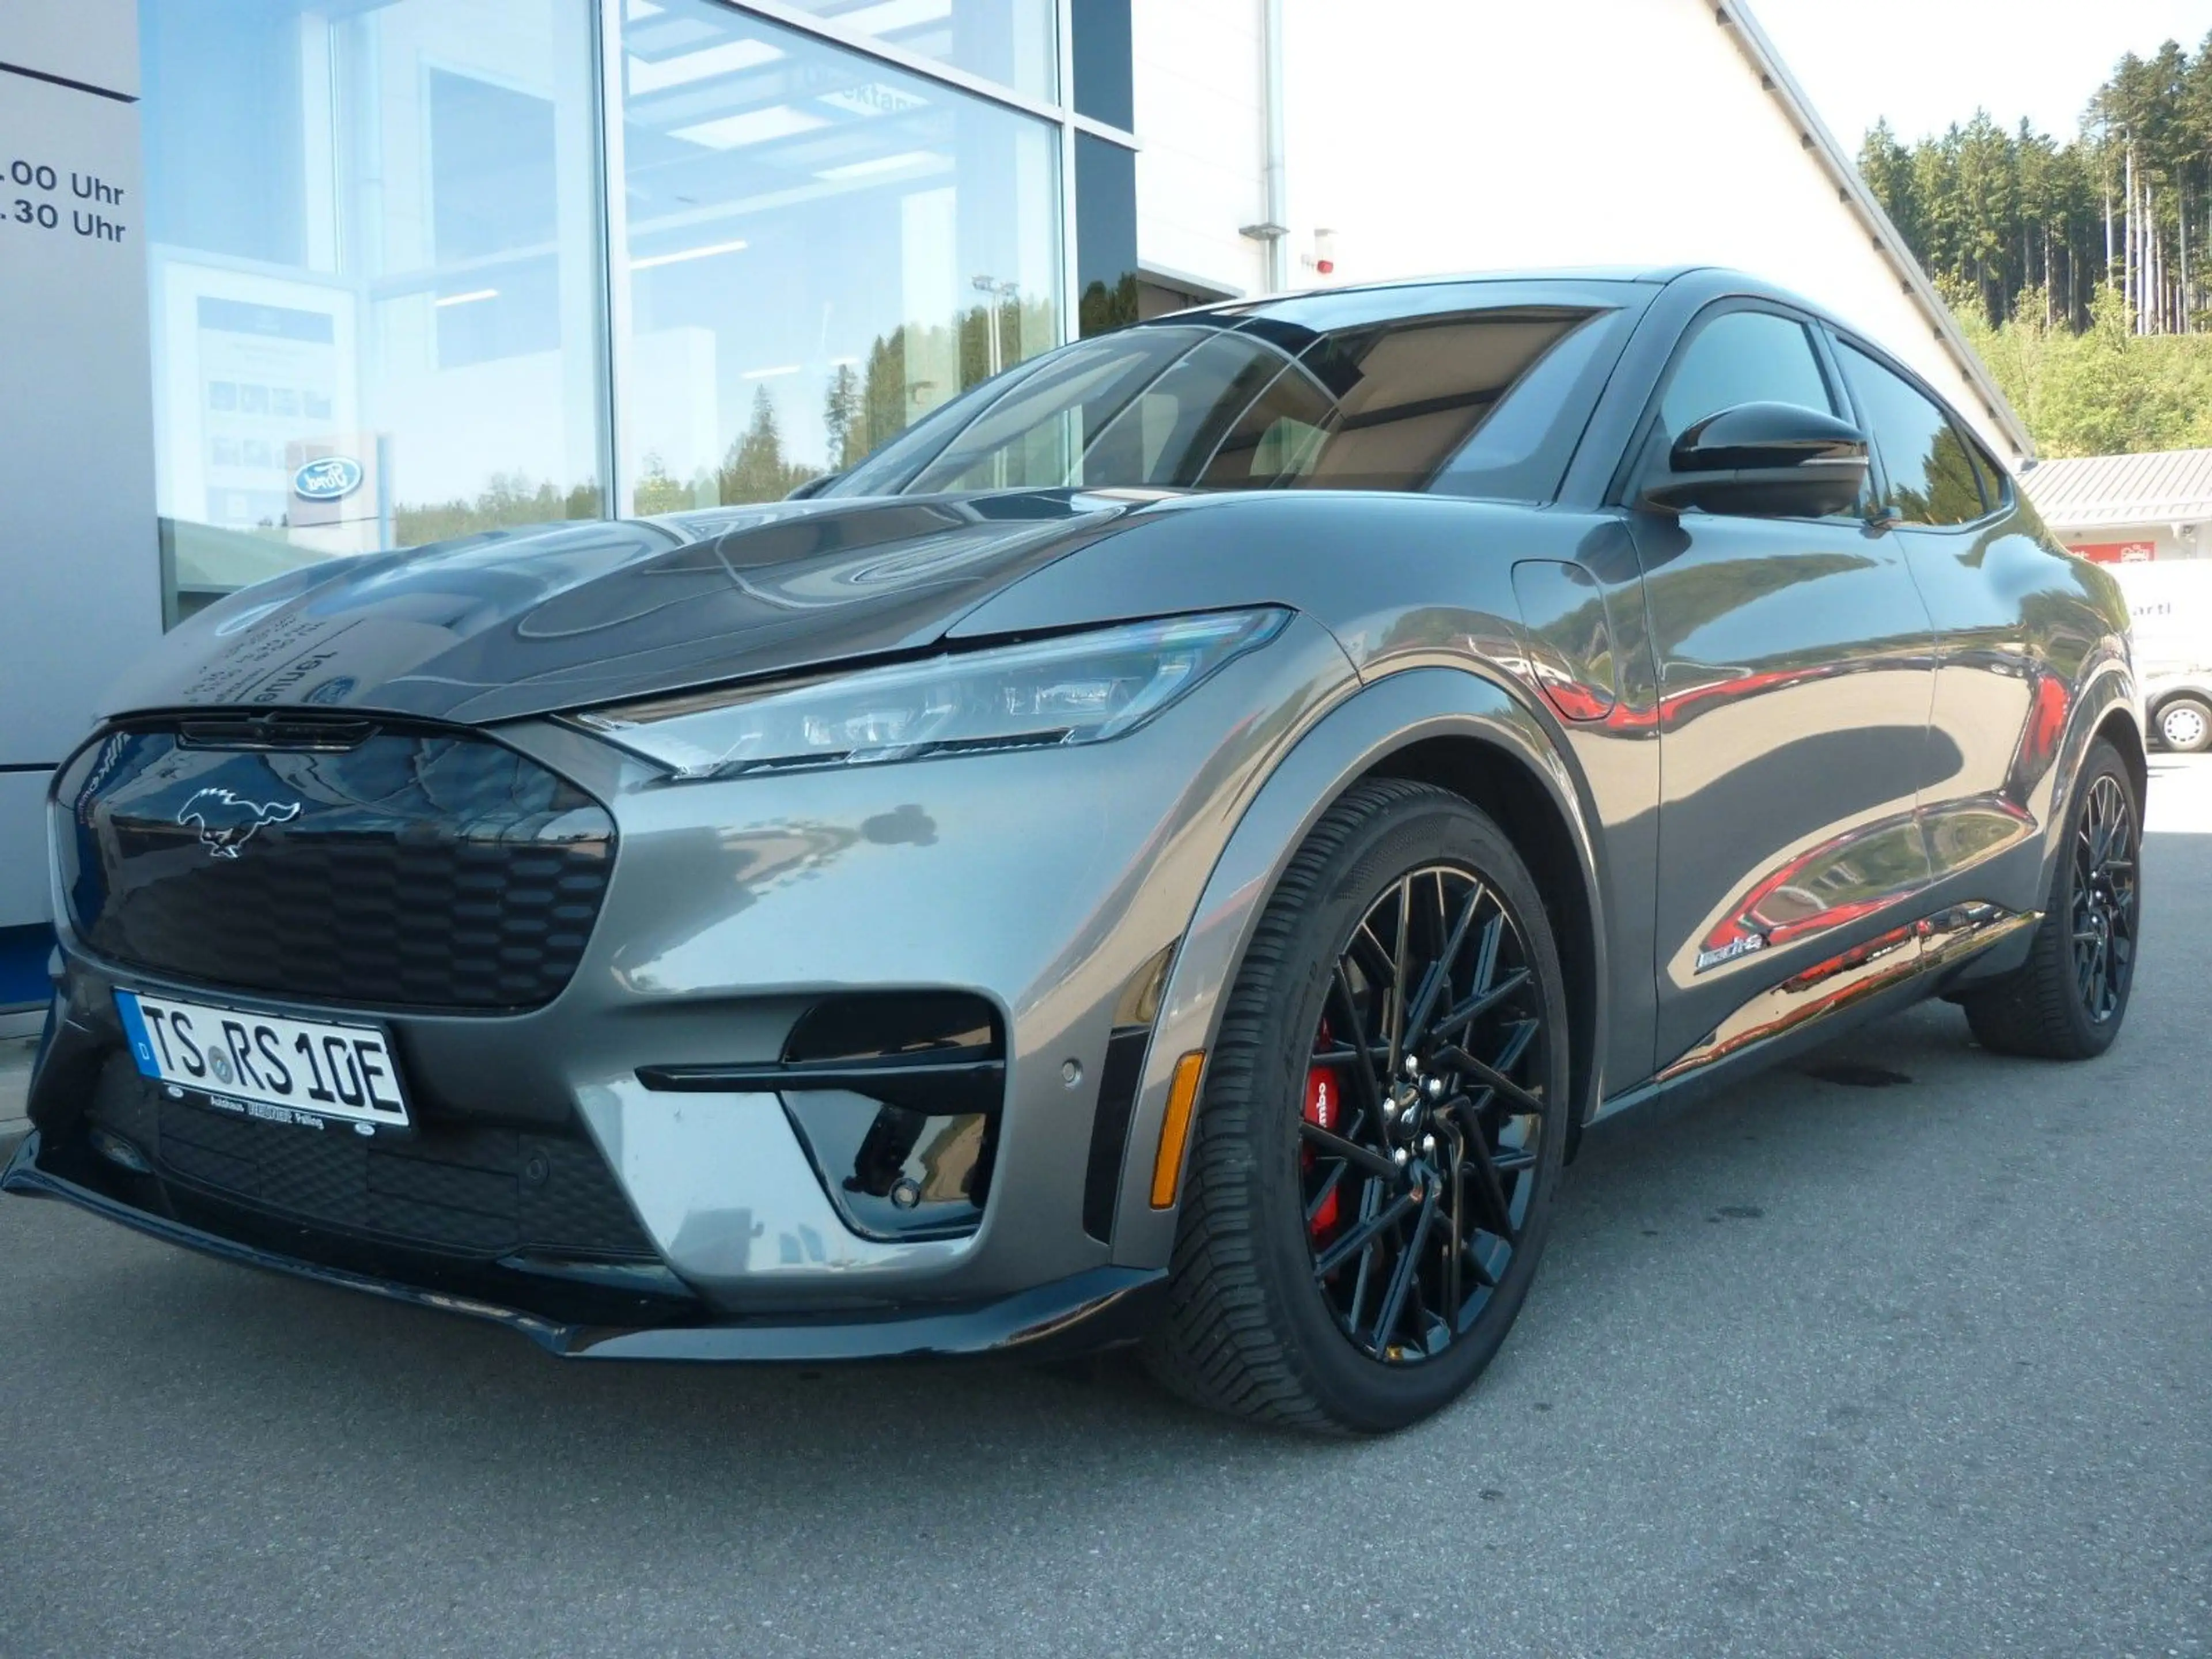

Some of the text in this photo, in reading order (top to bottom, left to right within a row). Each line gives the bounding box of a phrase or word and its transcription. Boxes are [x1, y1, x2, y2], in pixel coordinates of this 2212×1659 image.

[71, 173, 124, 205] Uhr
[73, 211, 126, 243] Uhr
[138, 1042, 150, 1060] D
[142, 1005, 403, 1113] TS RS 10E
[1316, 1082, 1327, 1127] mbo
